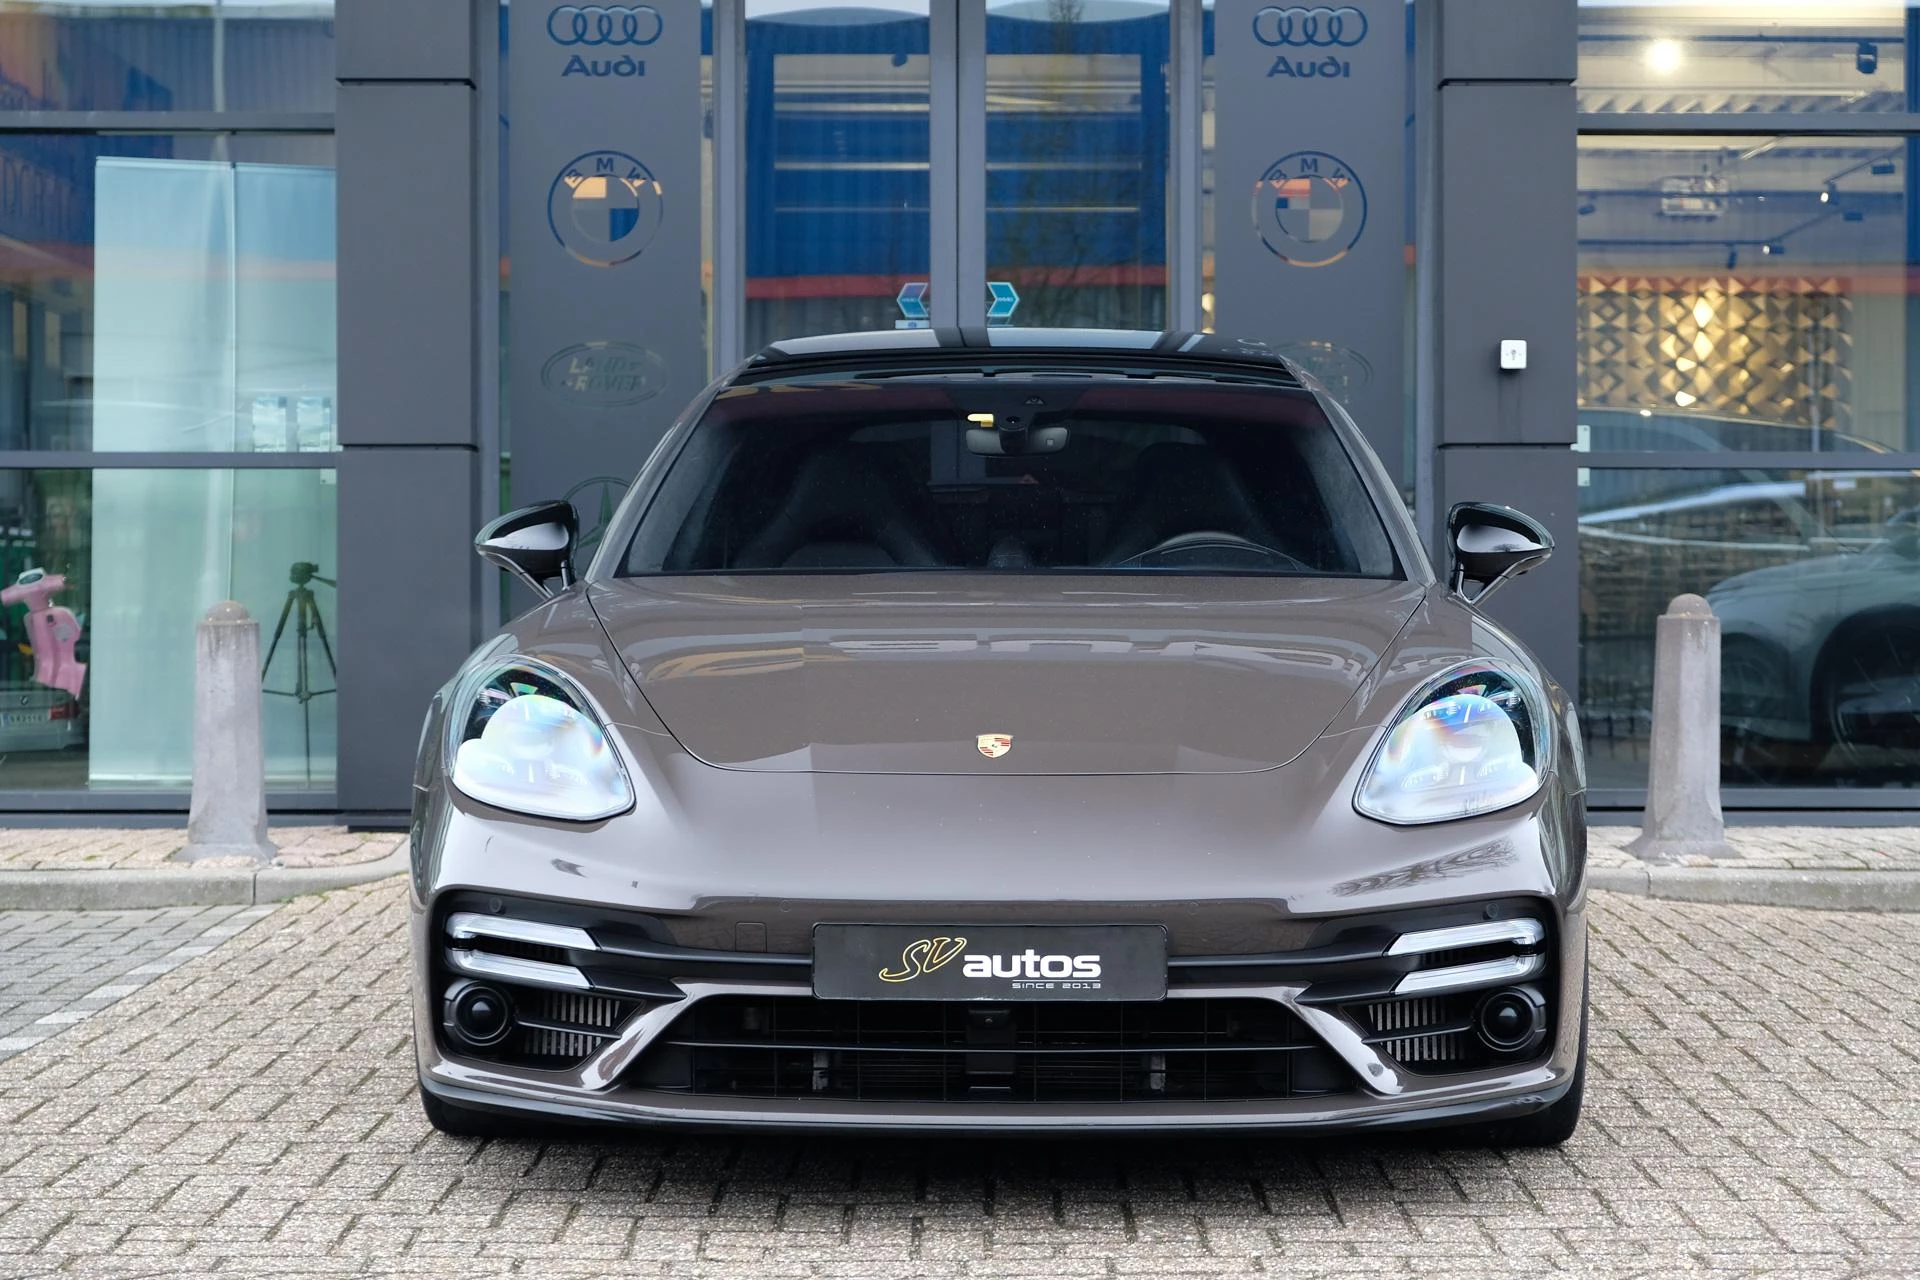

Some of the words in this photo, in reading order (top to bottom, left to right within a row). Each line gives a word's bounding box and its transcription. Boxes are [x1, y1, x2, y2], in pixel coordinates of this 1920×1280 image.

[561, 54, 645, 77] Audi
[1266, 55, 1350, 78] Audi
[563, 157, 647, 189] BMW
[1268, 157, 1352, 189] BMW
[878, 936, 968, 983] SV
[962, 948, 1102, 978] autos
[1011, 982, 1055, 990] SINCE
